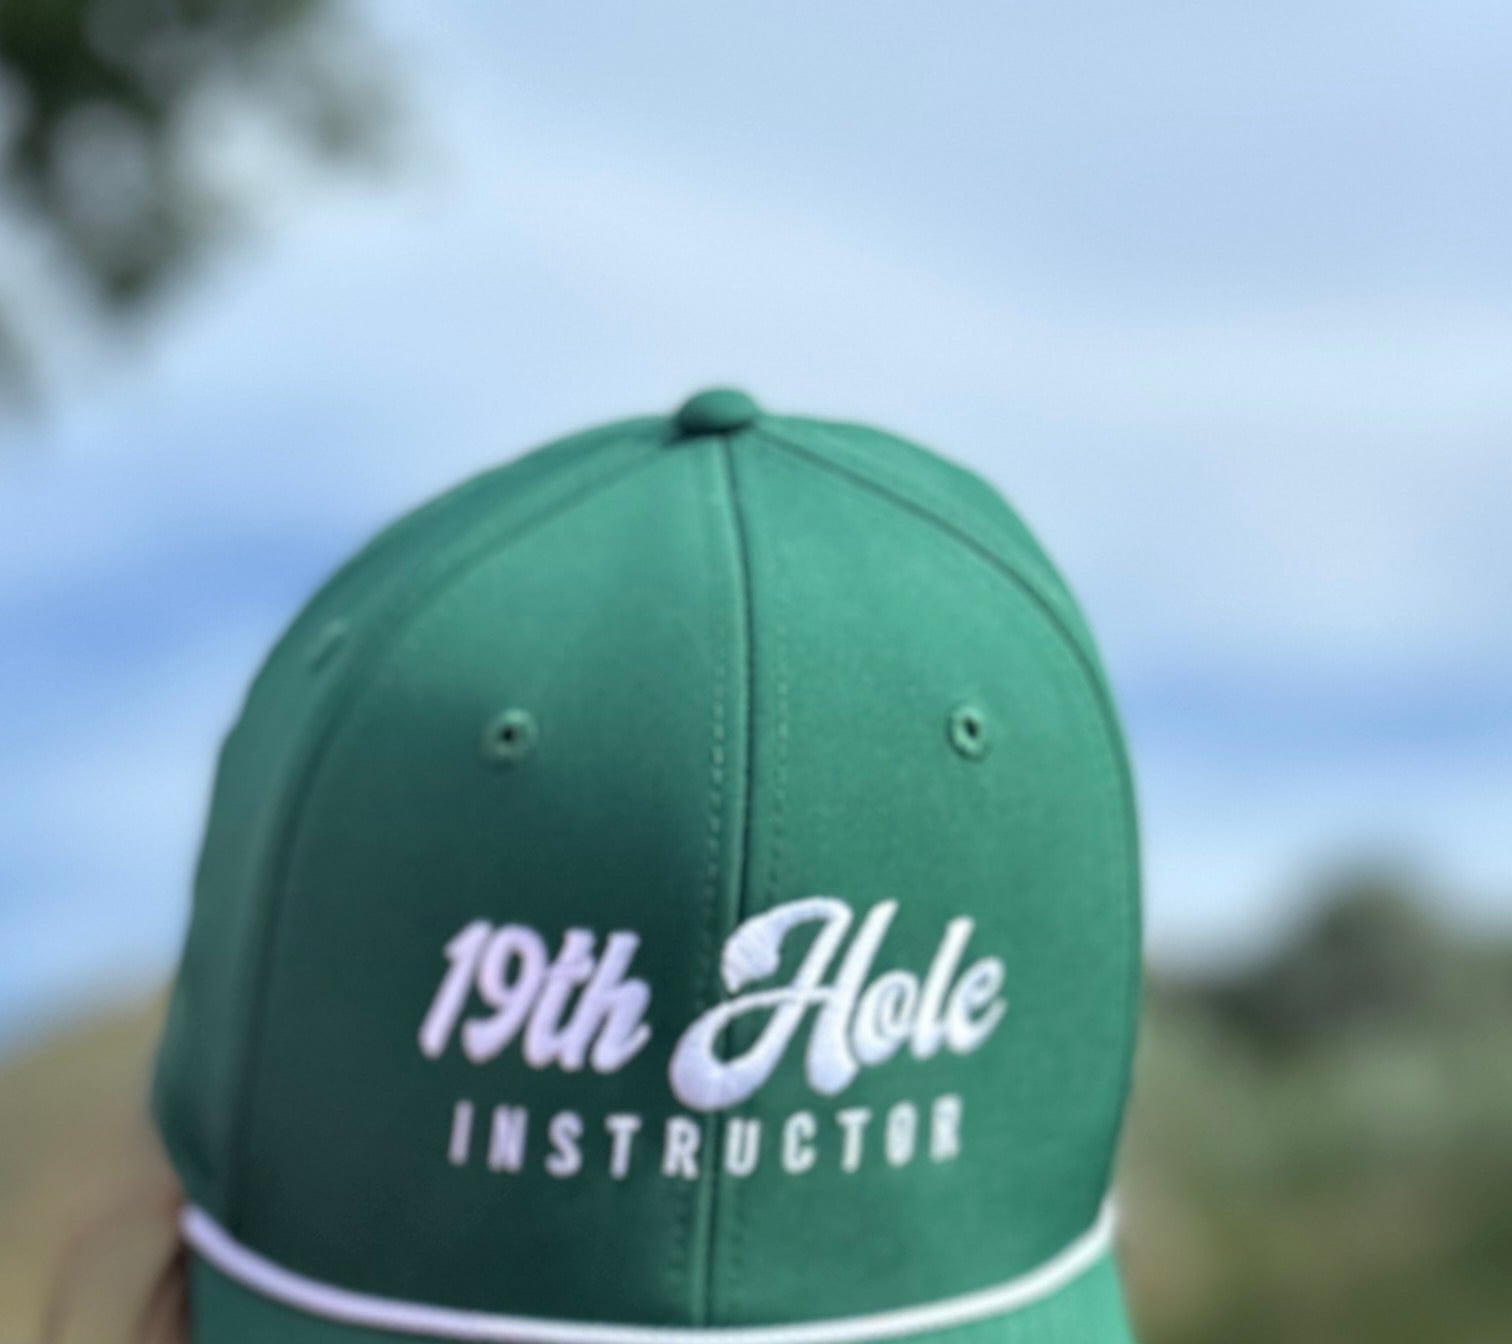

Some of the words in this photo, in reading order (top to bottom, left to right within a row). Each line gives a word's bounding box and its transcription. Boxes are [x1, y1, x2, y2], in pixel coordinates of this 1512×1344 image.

[418, 918, 652, 1074] 19th
[669, 896, 1007, 1112] Hole
[447, 1095, 962, 1180] INSTRUCTOR
